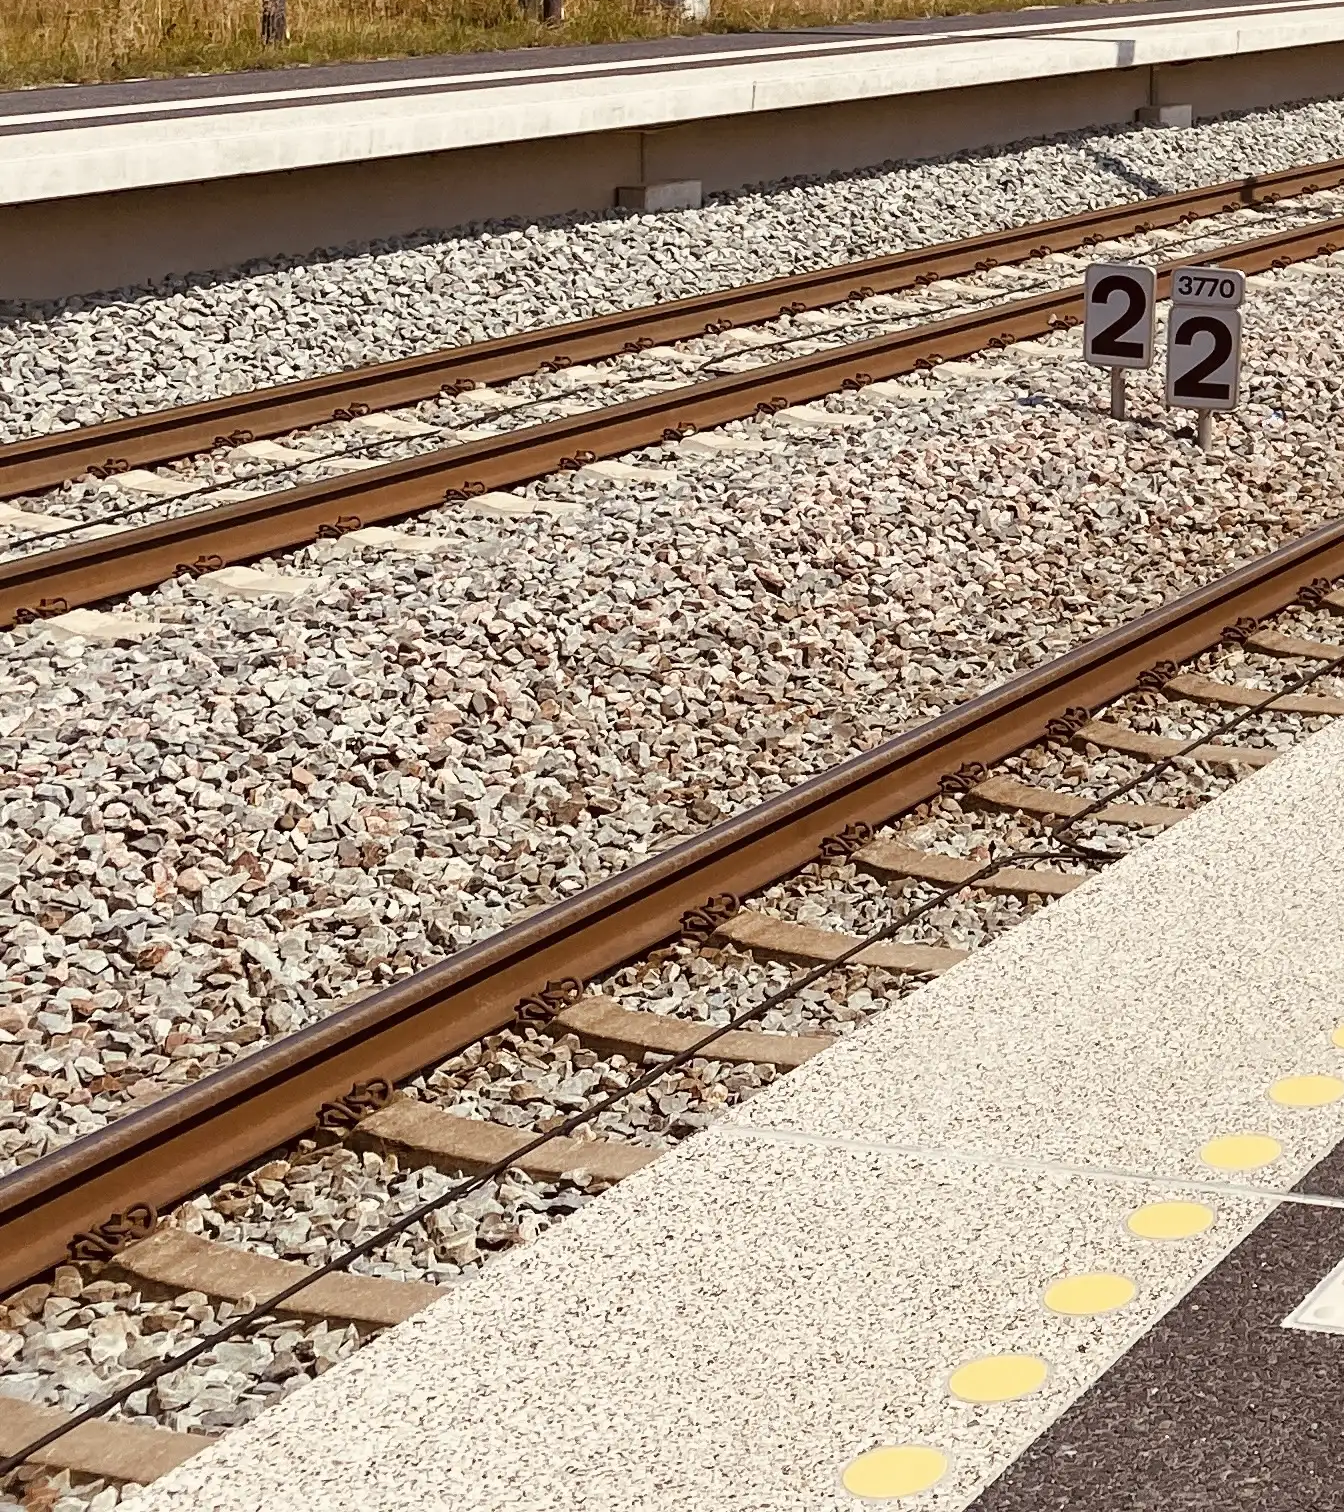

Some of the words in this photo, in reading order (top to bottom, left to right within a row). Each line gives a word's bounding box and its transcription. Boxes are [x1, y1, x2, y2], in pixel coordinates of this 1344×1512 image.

[1091, 274, 1147, 359] 2
[1178, 275, 1236, 299] 3770
[1173, 315, 1233, 400] 2
